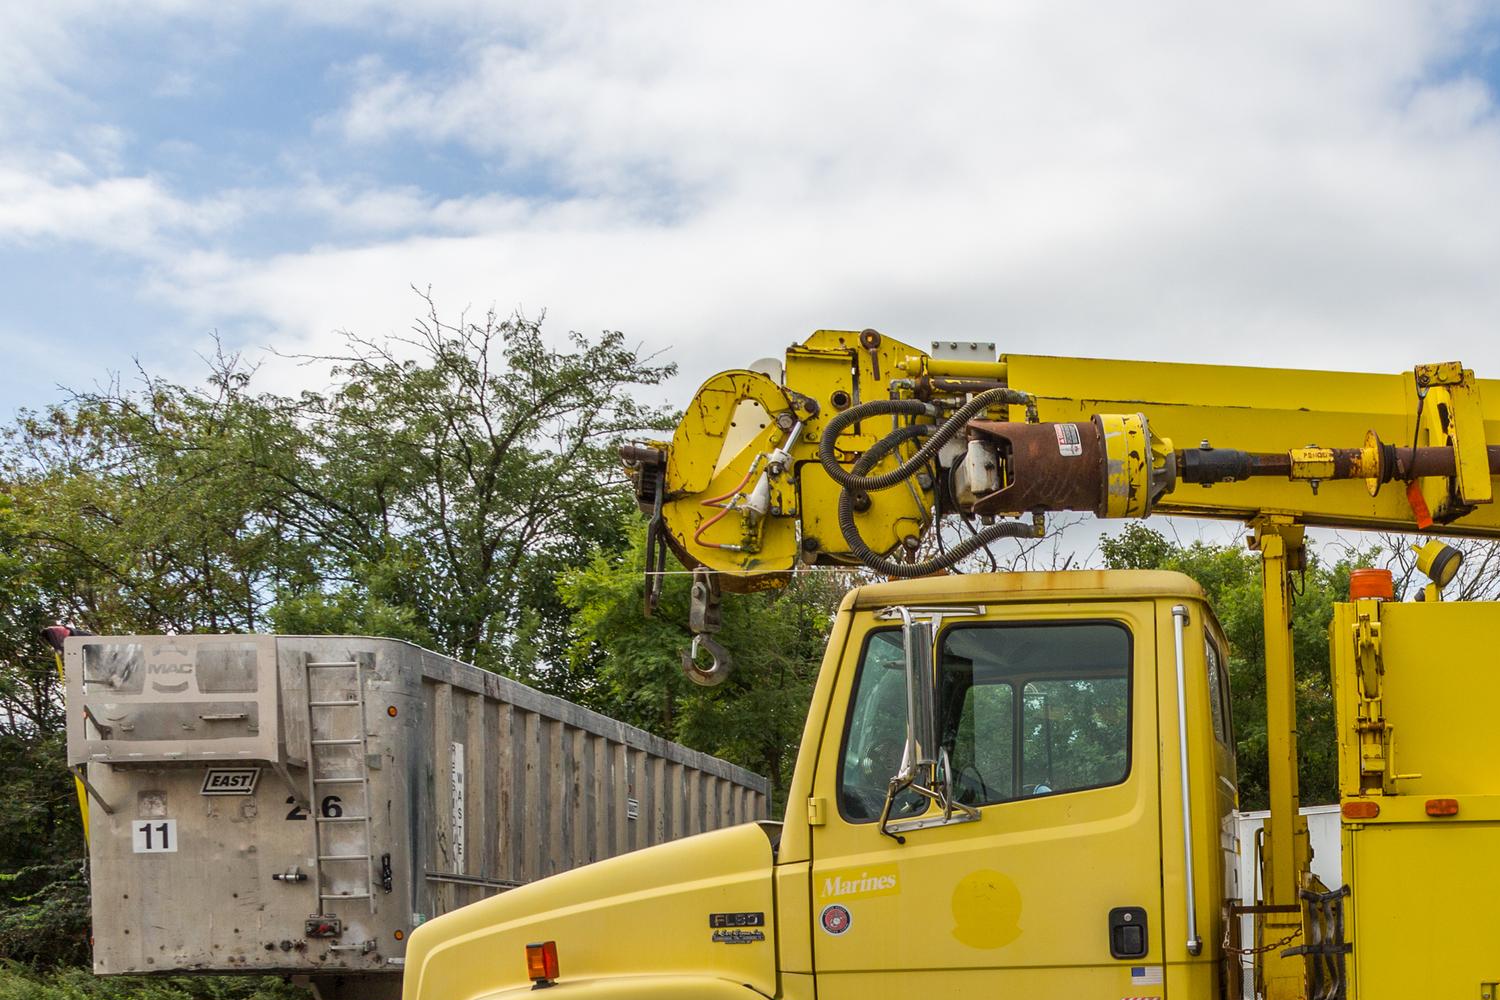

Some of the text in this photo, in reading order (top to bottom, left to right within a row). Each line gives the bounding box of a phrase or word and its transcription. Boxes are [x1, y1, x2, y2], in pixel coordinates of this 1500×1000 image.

[147, 663, 193, 674] MAC
[211, 775, 251, 787] EAST
[139, 822, 169, 850] 11
[821, 871, 897, 898] Marines
